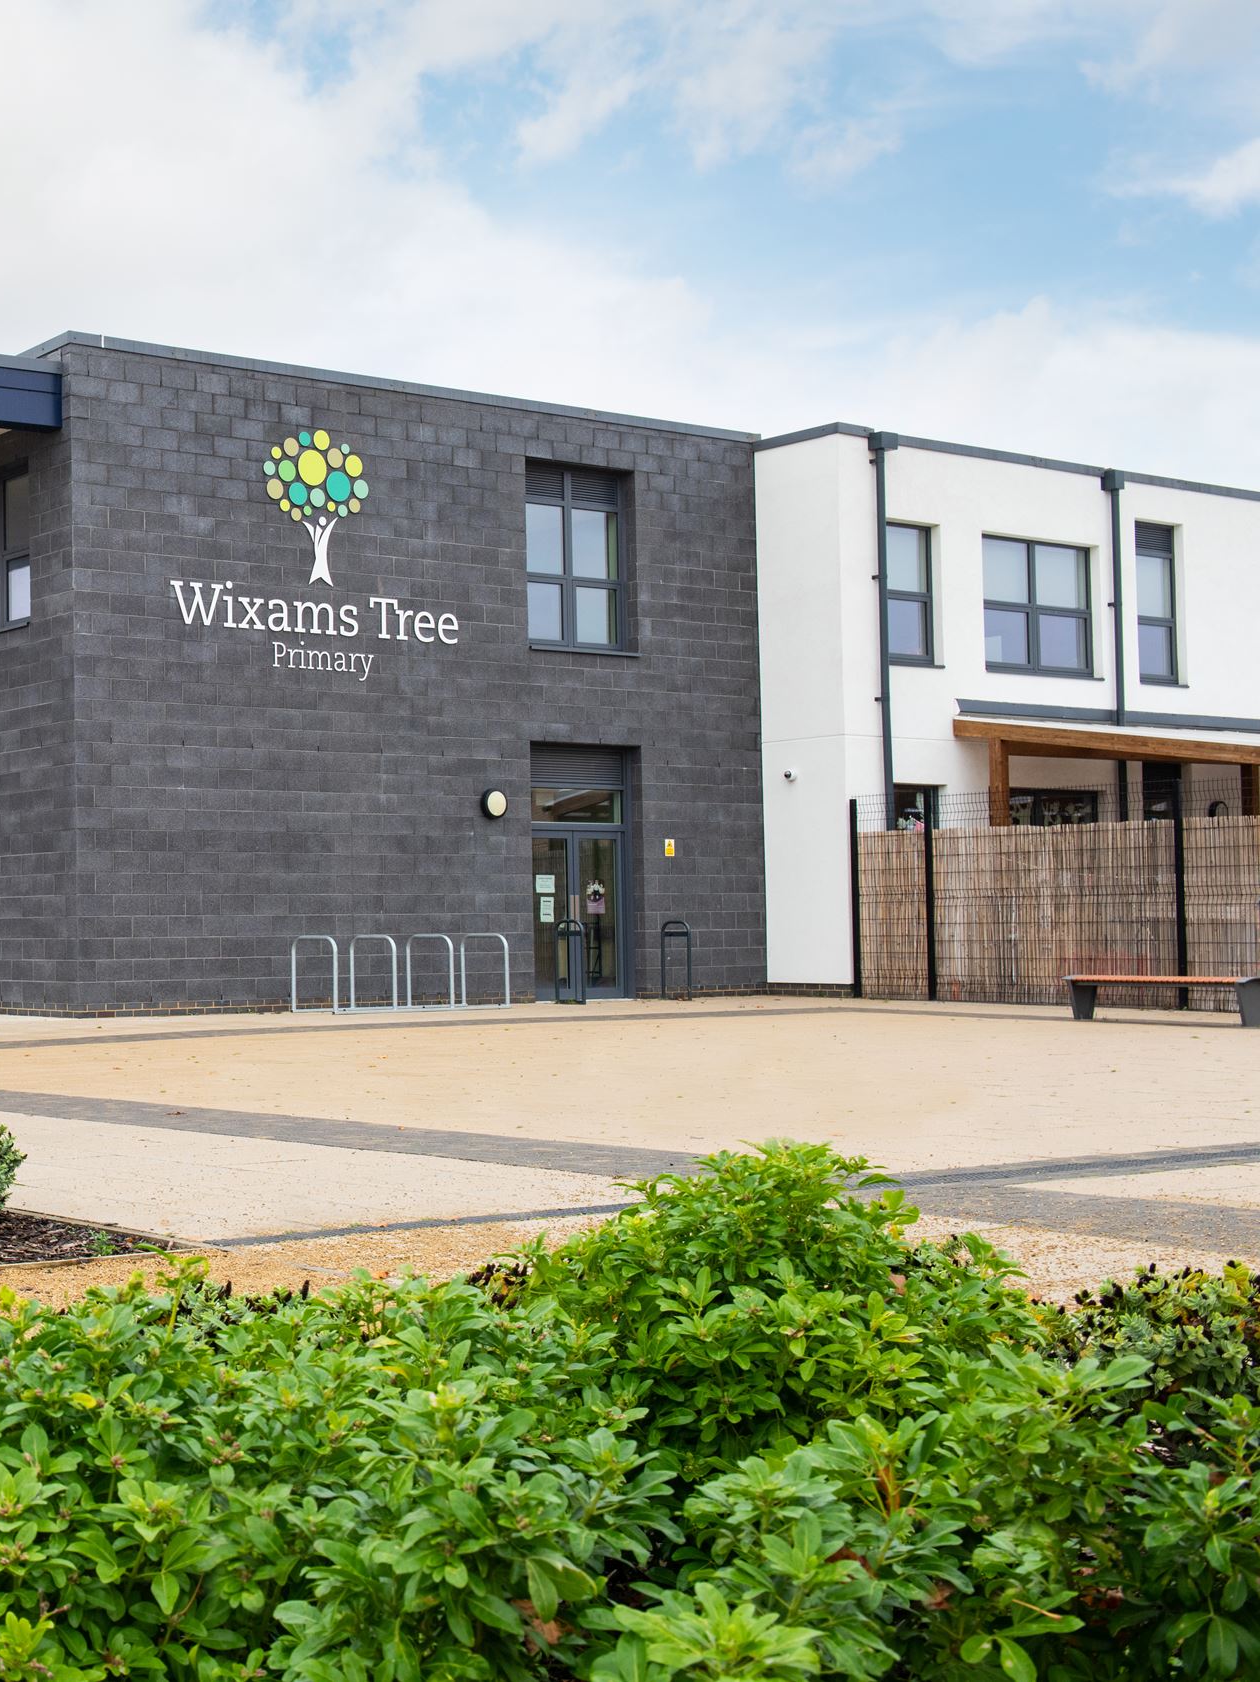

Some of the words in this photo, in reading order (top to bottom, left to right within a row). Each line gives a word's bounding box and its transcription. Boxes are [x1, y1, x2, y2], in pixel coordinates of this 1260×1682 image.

[170, 580, 359, 637] Wixams
[369, 596, 459, 645] Tree
[272, 640, 374, 681] Primary
